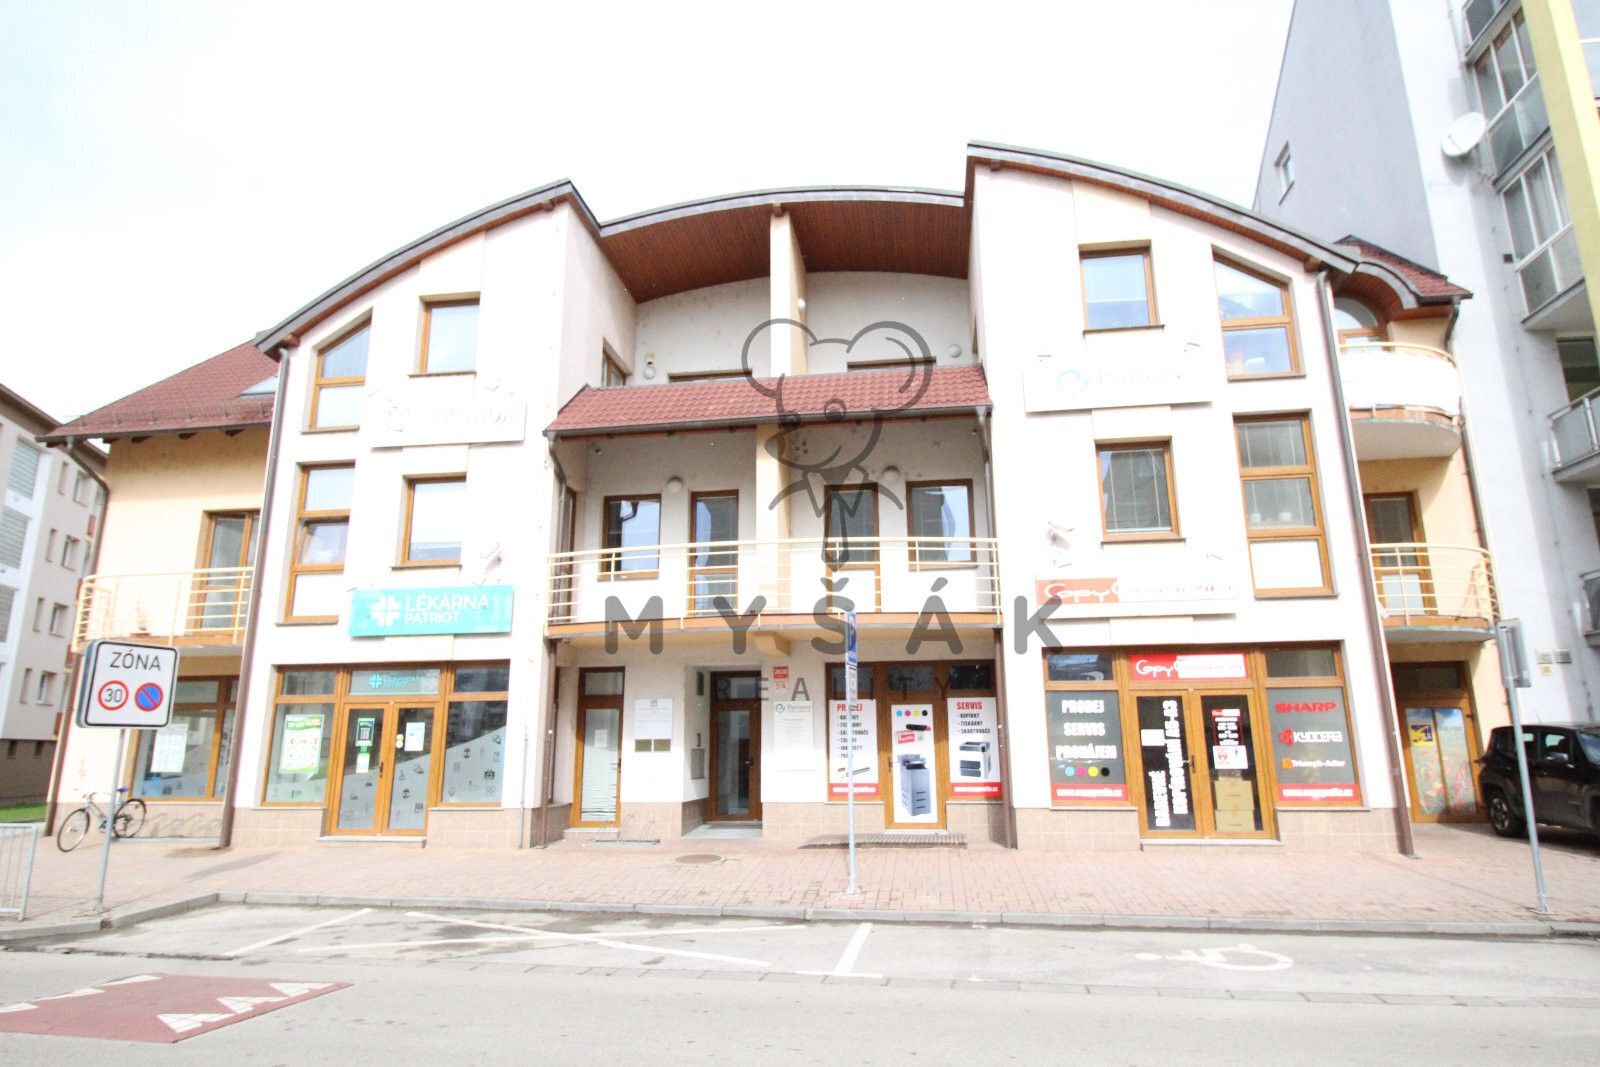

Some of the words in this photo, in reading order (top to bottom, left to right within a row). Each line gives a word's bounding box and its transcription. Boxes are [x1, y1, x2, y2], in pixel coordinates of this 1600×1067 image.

[404, 592, 489, 612] LÉKÁRNA
[404, 611, 460, 625] PATRIOT
[110, 649, 162, 671] ZÓNA
[104, 688, 123, 703] 30
[956, 702, 983, 710] SERVIS
[1061, 699, 1105, 714] PRODEJ
[1275, 702, 1337, 713] SHARP
[1063, 721, 1106, 736] SERVIS
[1292, 731, 1343, 742] KYOCERA
[1291, 759, 1346, 769] Triumph-Adler
